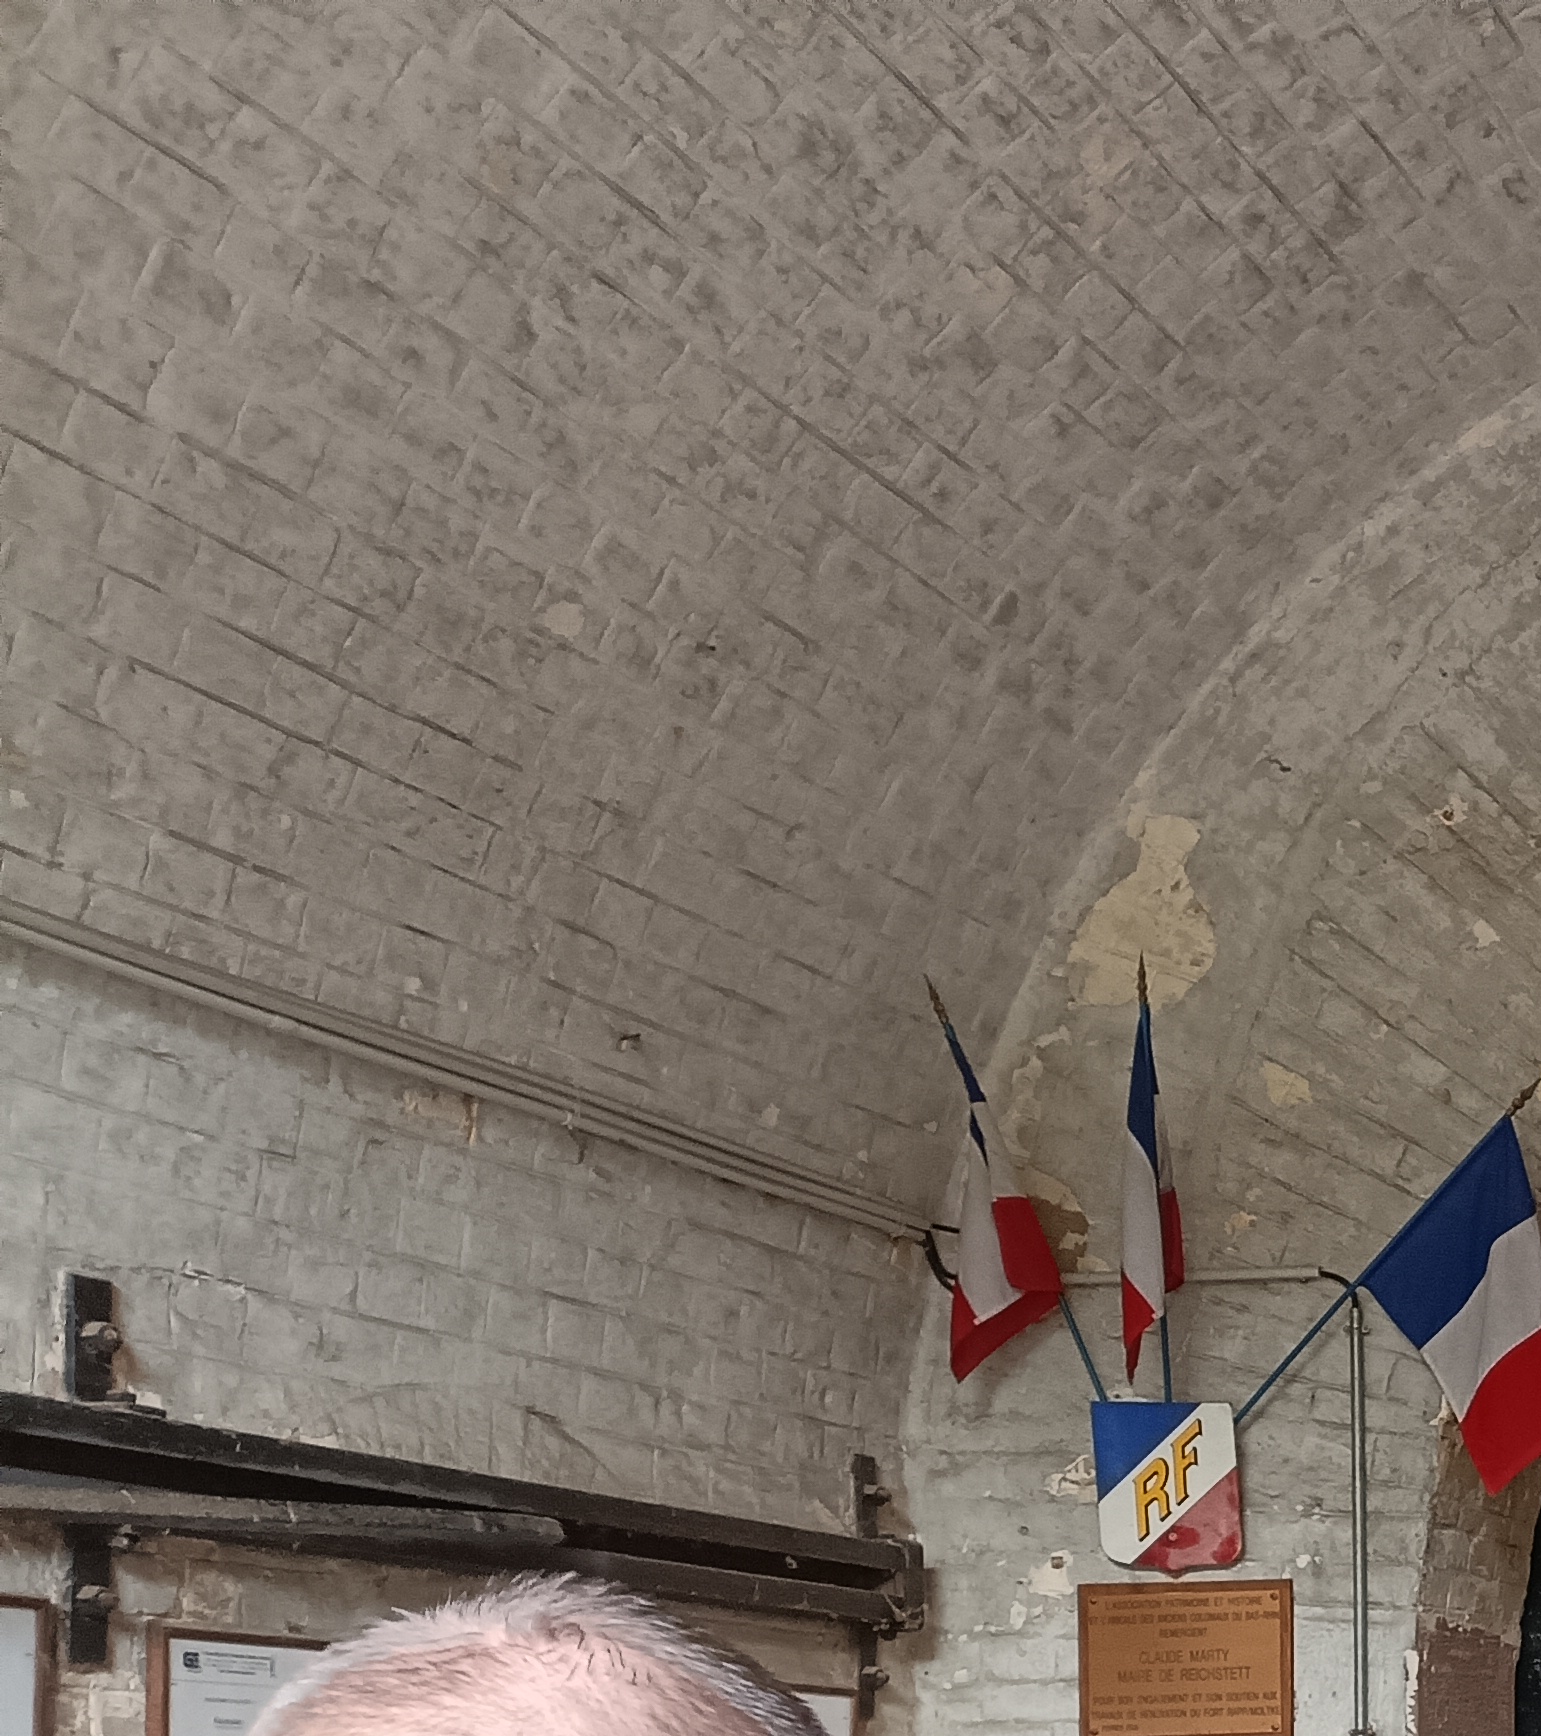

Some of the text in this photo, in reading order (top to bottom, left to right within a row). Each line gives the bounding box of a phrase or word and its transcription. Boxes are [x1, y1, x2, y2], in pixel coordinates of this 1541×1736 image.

[1132, 1418, 1202, 1541] RF
[1138, 1648, 1230, 1664] CLAUDE MARTY
[1117, 1665, 1251, 1683] MAIRE DE REICHSTETT
